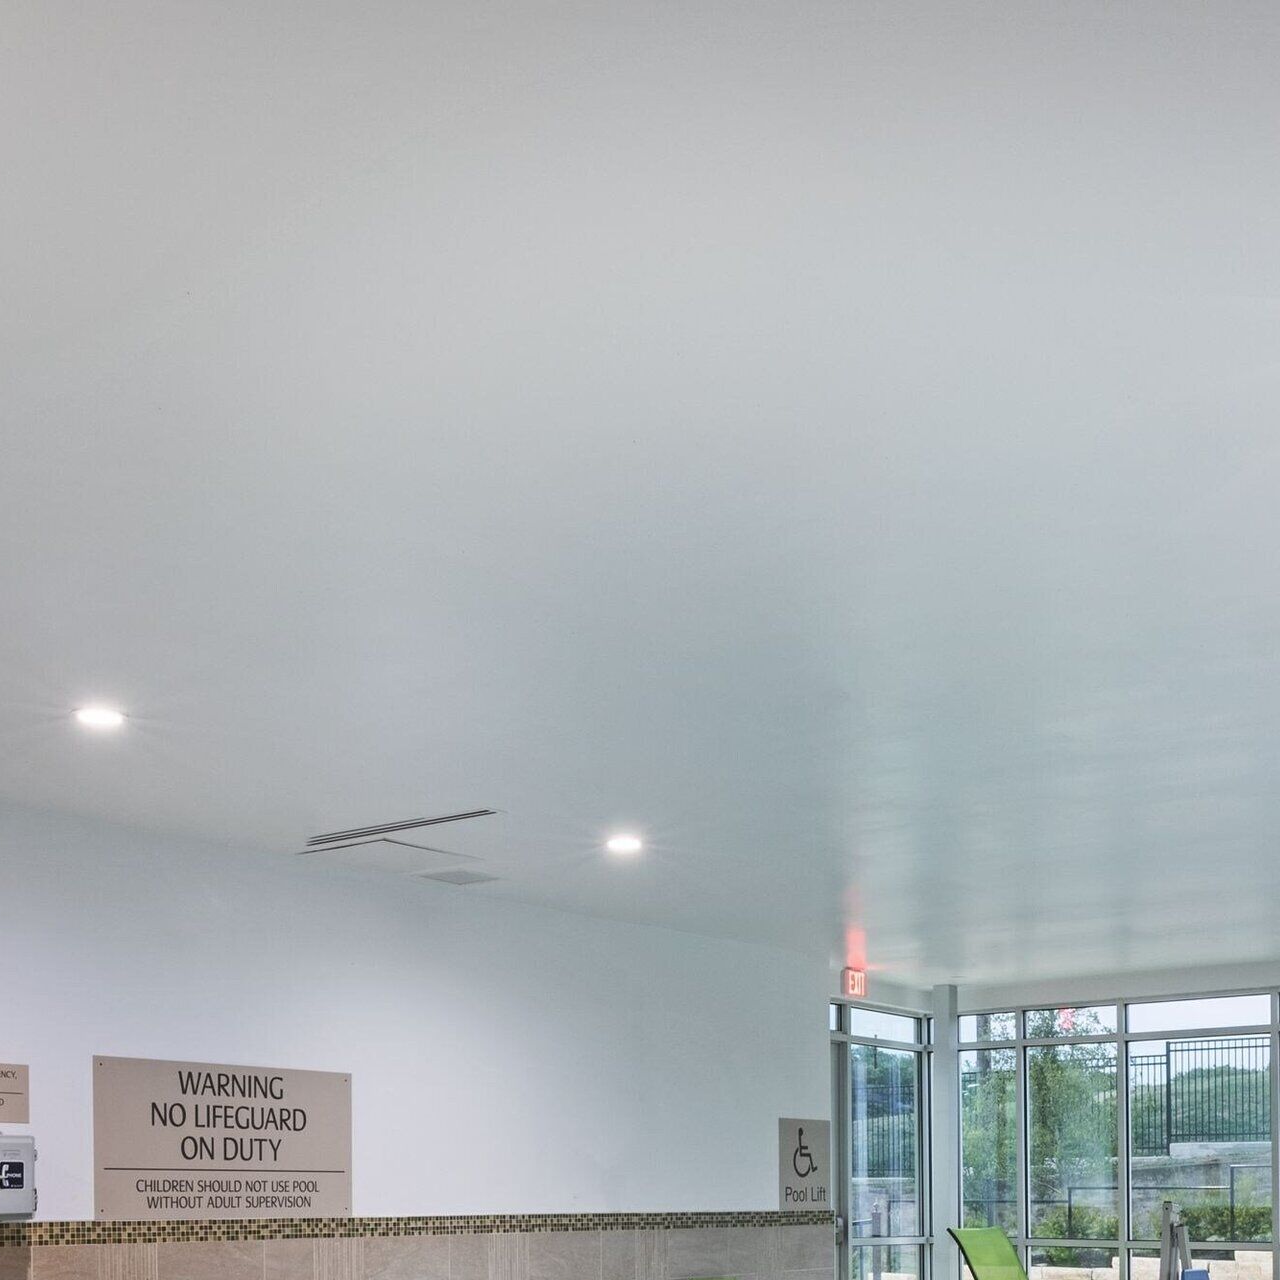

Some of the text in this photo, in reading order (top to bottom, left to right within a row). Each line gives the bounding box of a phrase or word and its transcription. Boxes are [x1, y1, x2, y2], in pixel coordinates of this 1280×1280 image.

[848, 970, 864, 996] EXIT
[178, 1070, 284, 1100] WARNING
[151, 1102, 307, 1132] NO LIFEGUARD
[180, 1136, 282, 1162] ON DUTY
[136, 1179, 320, 1193] CHILDREN SHOULD NOT USE POOL
[785, 1186, 826, 1202] Pool Lift
[147, 1195, 311, 1209] WITHOUT ADULT SUPERVISION
